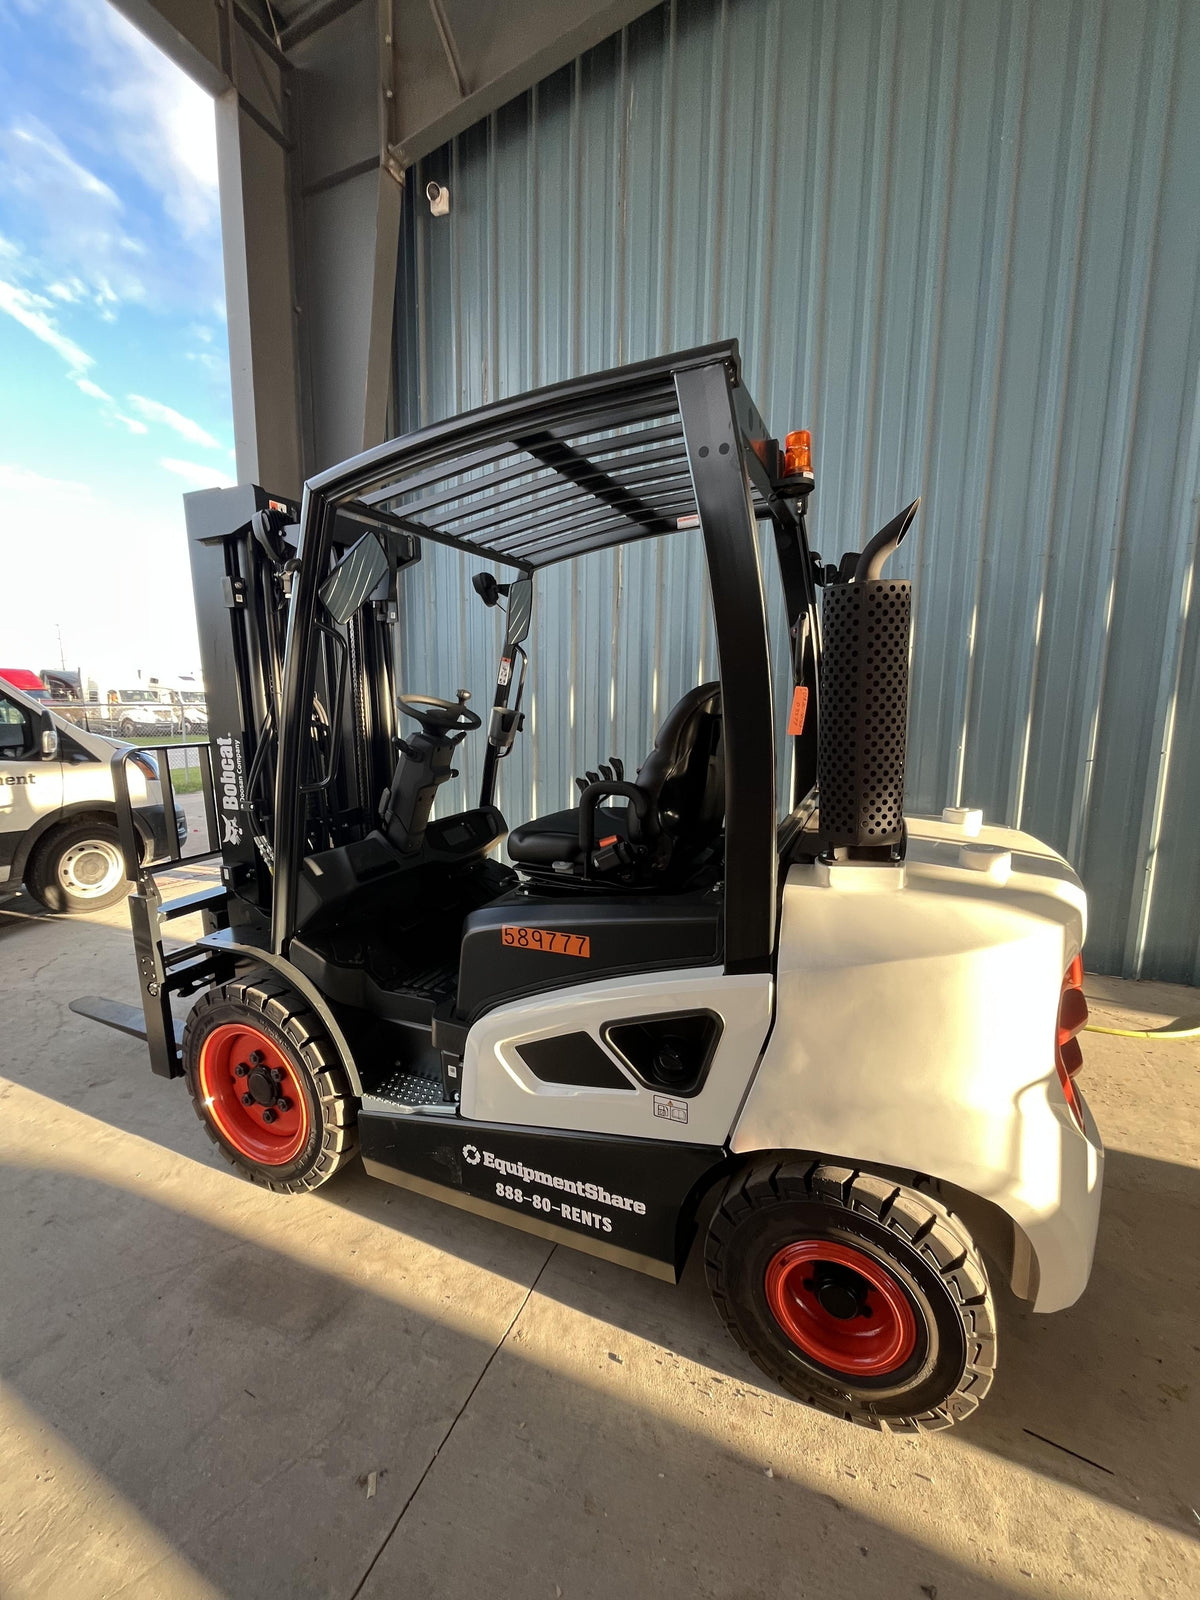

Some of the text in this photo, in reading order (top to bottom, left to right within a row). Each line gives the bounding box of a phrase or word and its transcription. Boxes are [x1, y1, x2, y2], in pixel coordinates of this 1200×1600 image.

[217, 737, 239, 810] Bobcat
[504, 927, 586, 955] 589777
[482, 1150, 646, 1215] EquipmentShare
[495, 1182, 613, 1233] 888-80-RENTS
